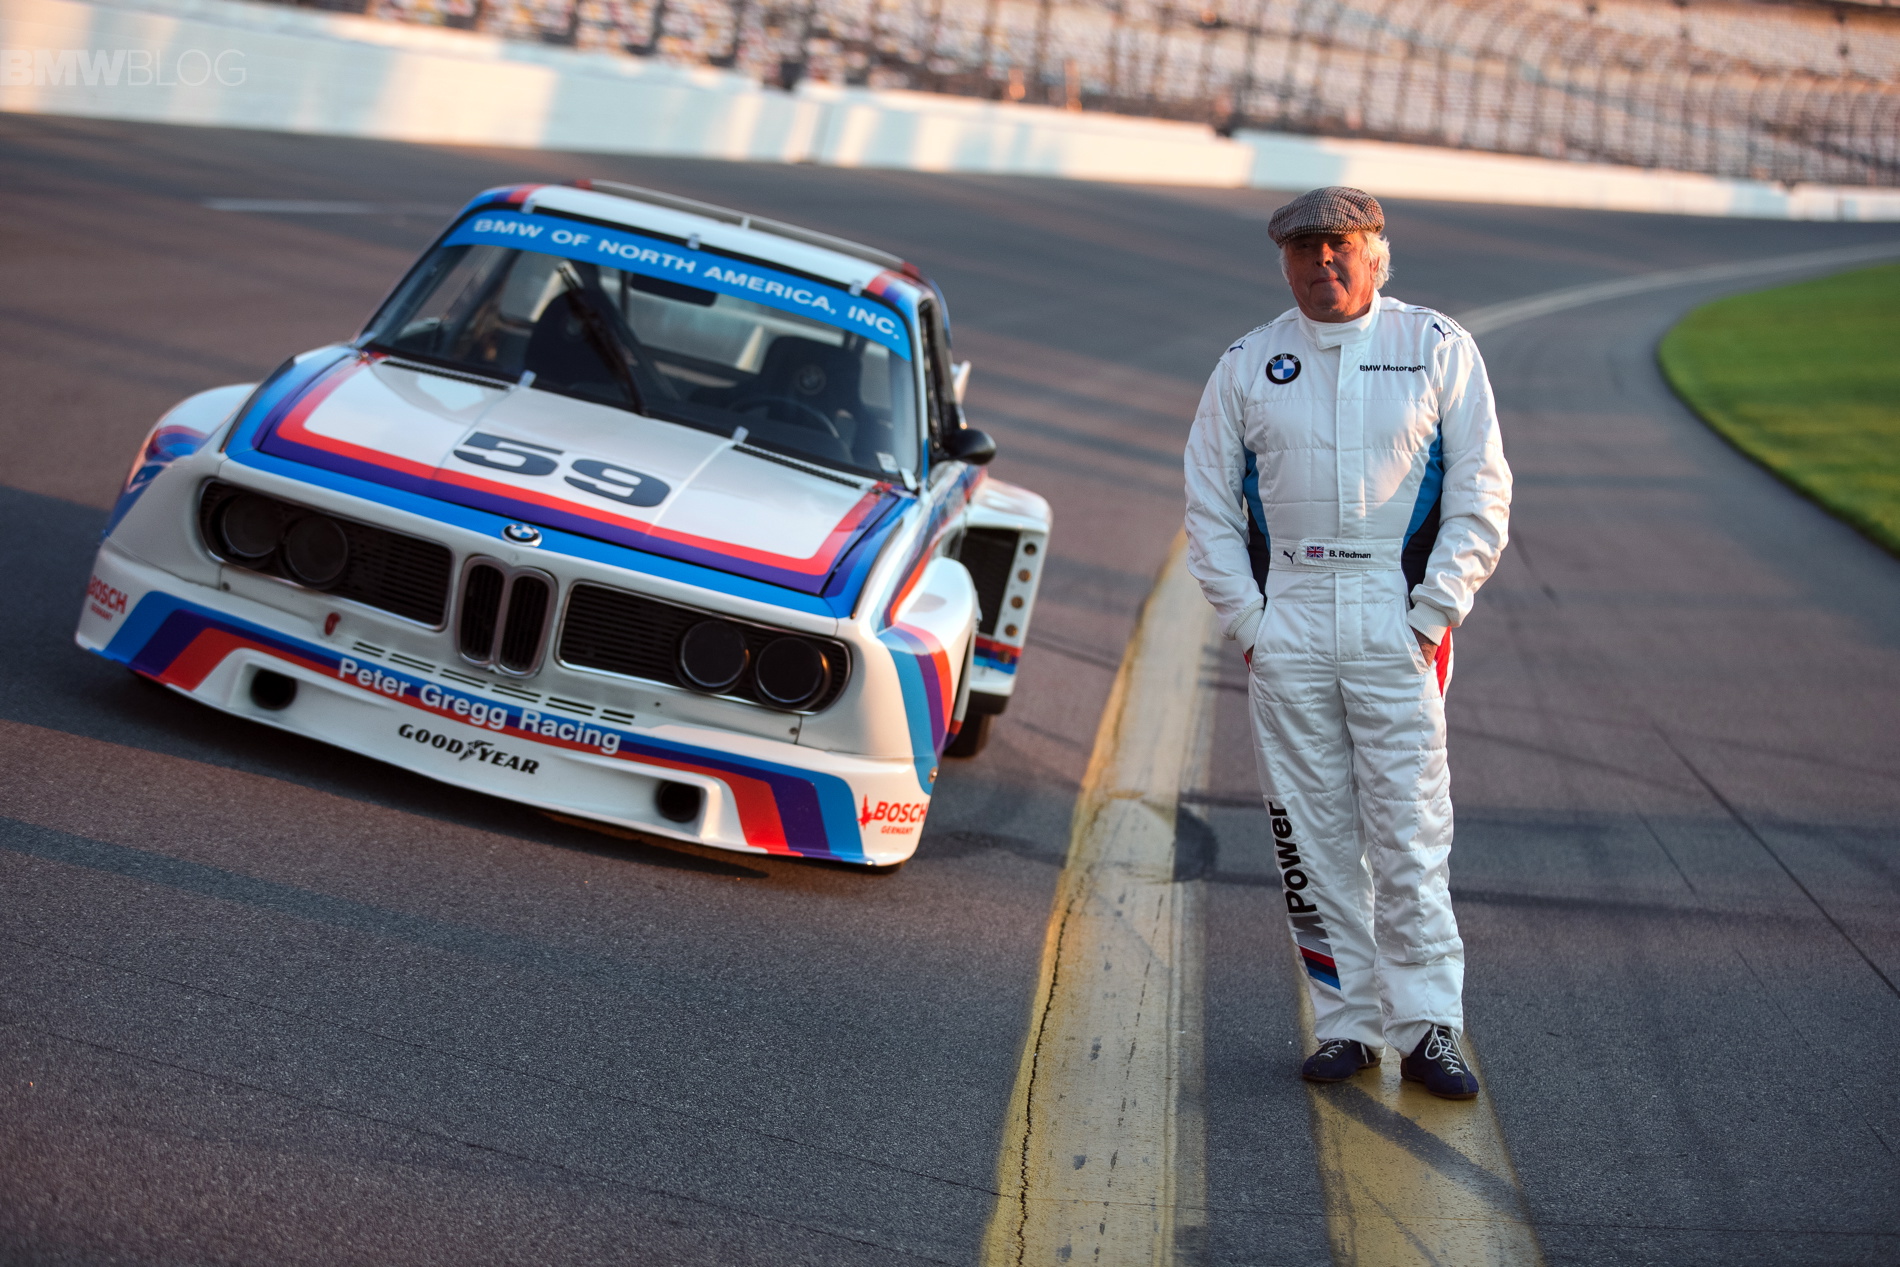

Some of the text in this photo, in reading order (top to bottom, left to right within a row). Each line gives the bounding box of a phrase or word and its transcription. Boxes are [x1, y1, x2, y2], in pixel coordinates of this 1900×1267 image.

[473, 218, 900, 341] BMW OF NORTH AMERICA, INC.
[1359, 364, 1381, 372] BMW
[453, 431, 672, 508] 59
[1329, 549, 1372, 559] B. Redman
[338, 657, 621, 754] Peter Gregg Racing
[873, 800, 929, 823] BOSCH
